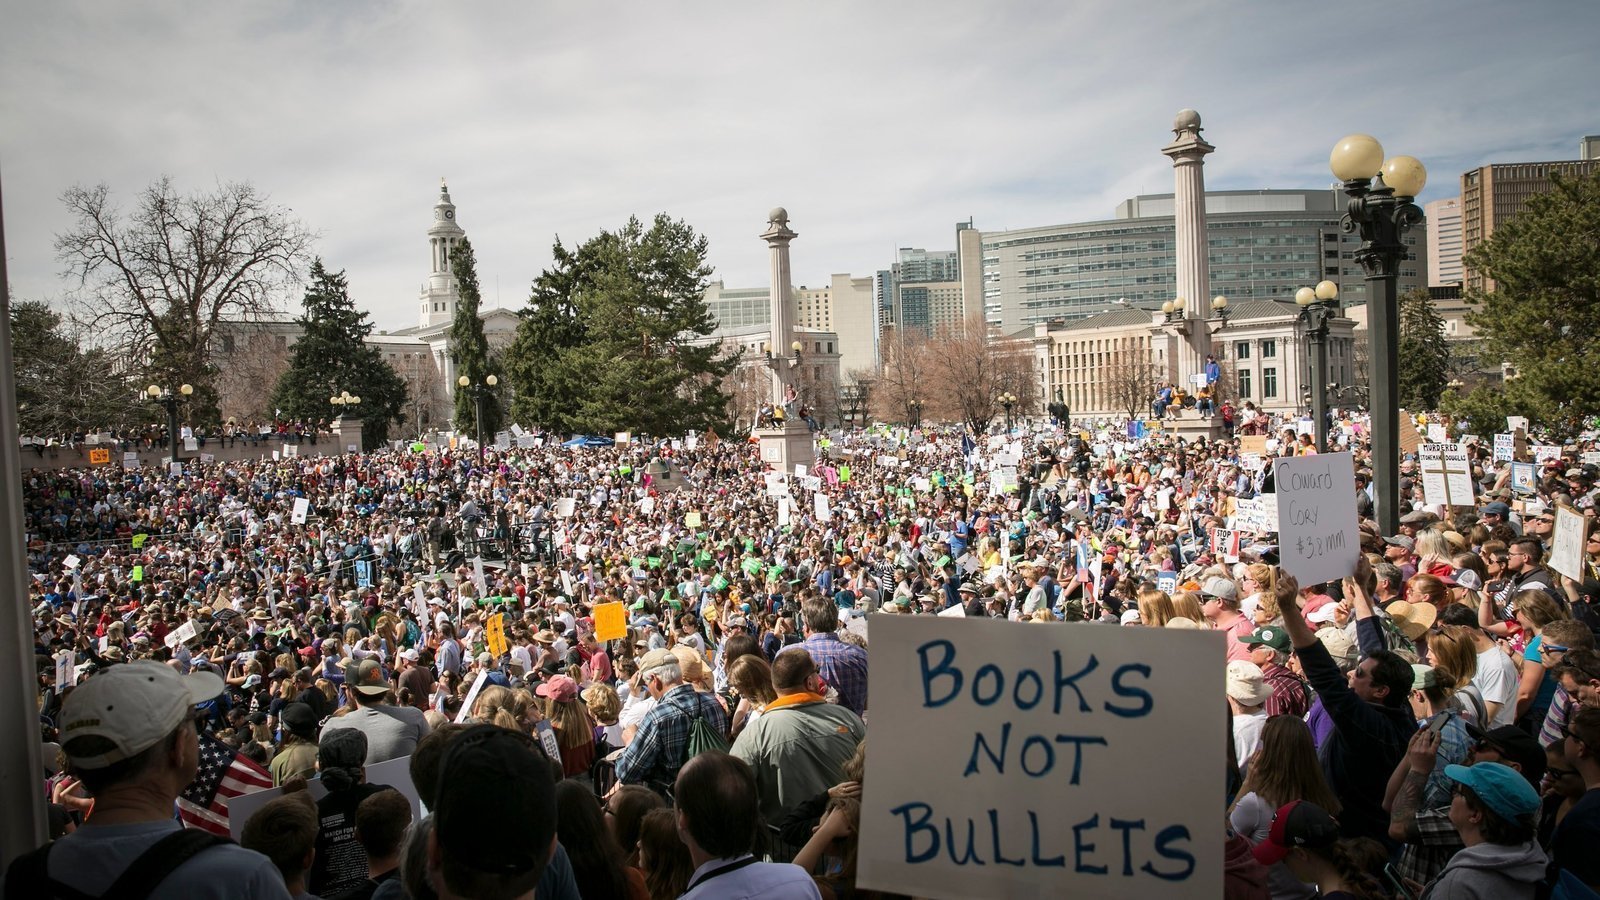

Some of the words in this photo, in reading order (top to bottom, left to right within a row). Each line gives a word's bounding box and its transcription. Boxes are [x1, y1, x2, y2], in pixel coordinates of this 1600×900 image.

[1217, 529, 1231, 538] STOP
[916, 639, 1154, 718] BOOKS
[963, 722, 1108, 785] NOT
[890, 802, 1196, 882] BULLETS
